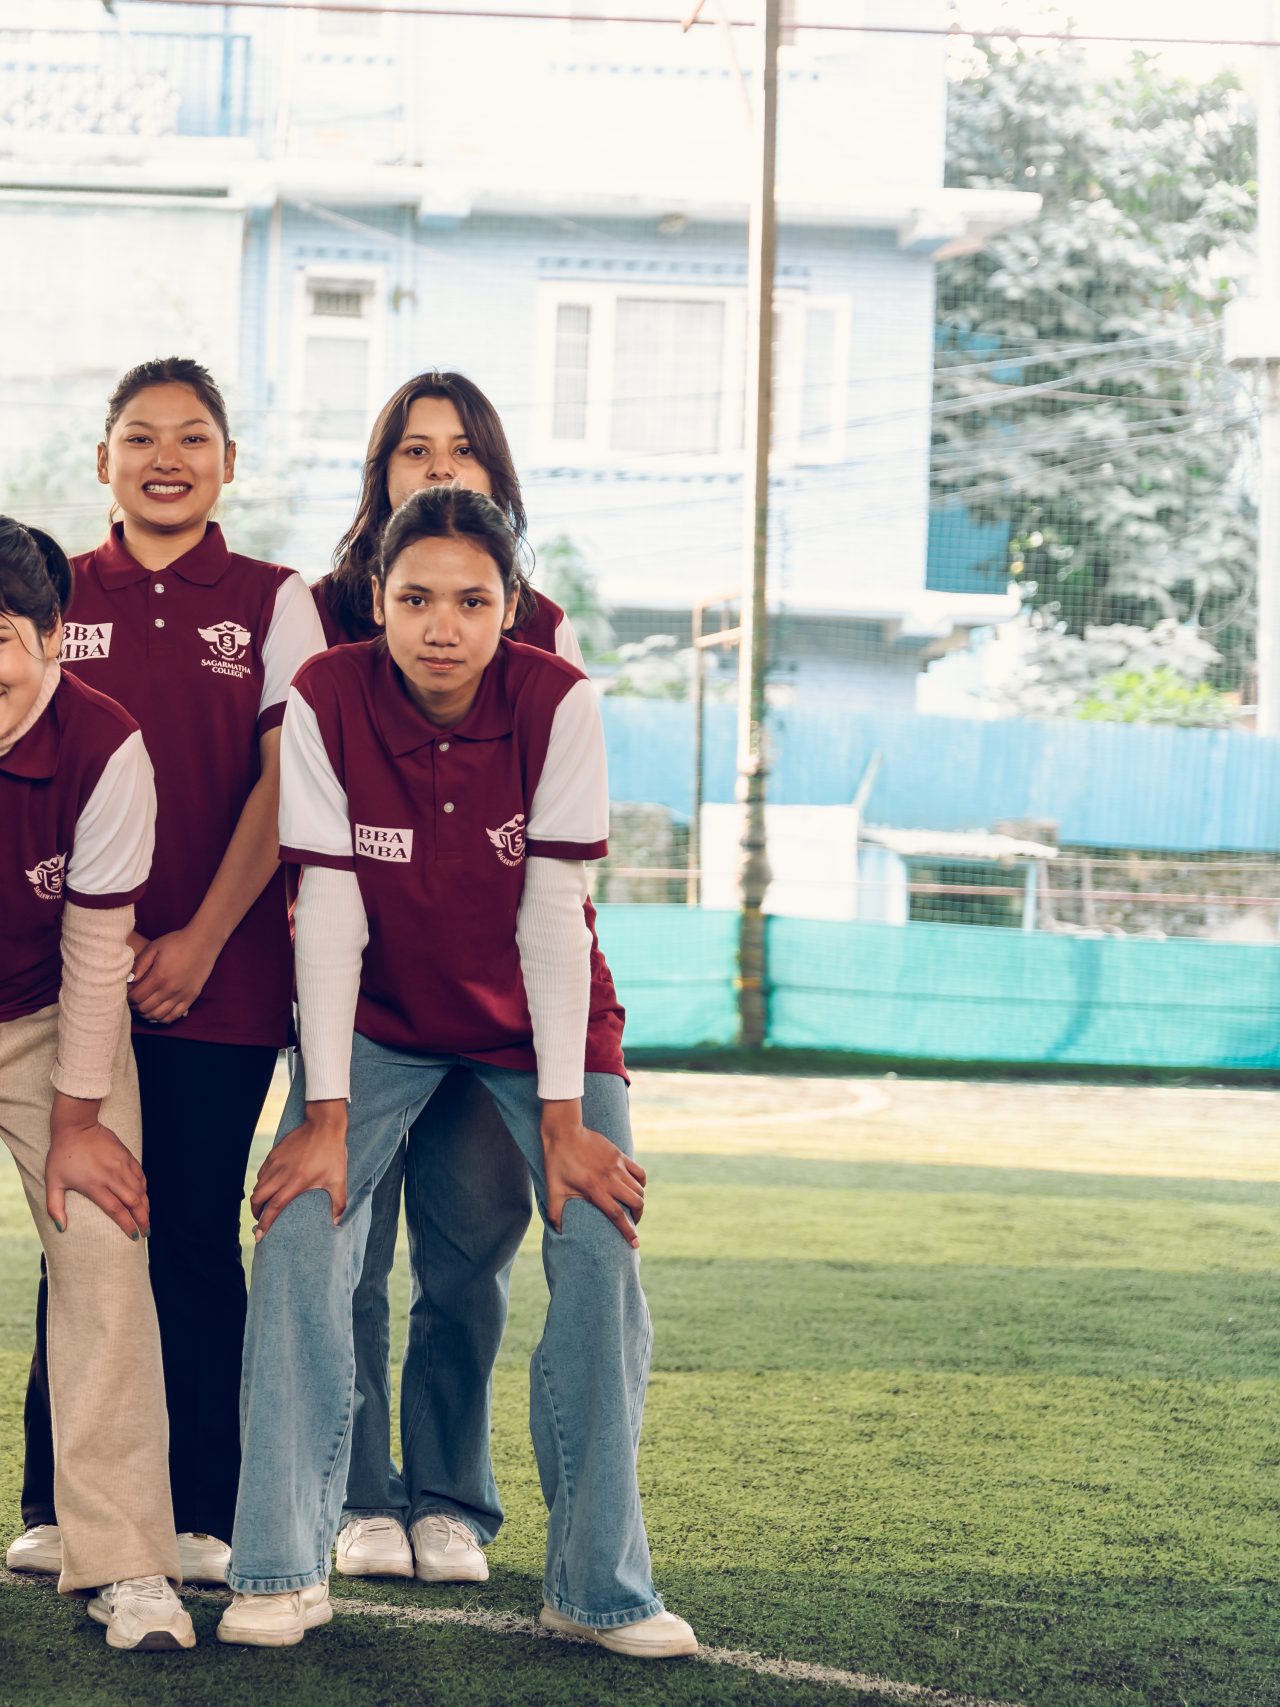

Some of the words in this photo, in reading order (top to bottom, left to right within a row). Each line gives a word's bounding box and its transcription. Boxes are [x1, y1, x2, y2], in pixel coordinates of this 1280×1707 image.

[201, 658, 251, 675] SAGARMATHA
[211, 666, 244, 678] COLLEGE
[359, 827, 404, 844] BBA
[359, 841, 408, 859] MBA
